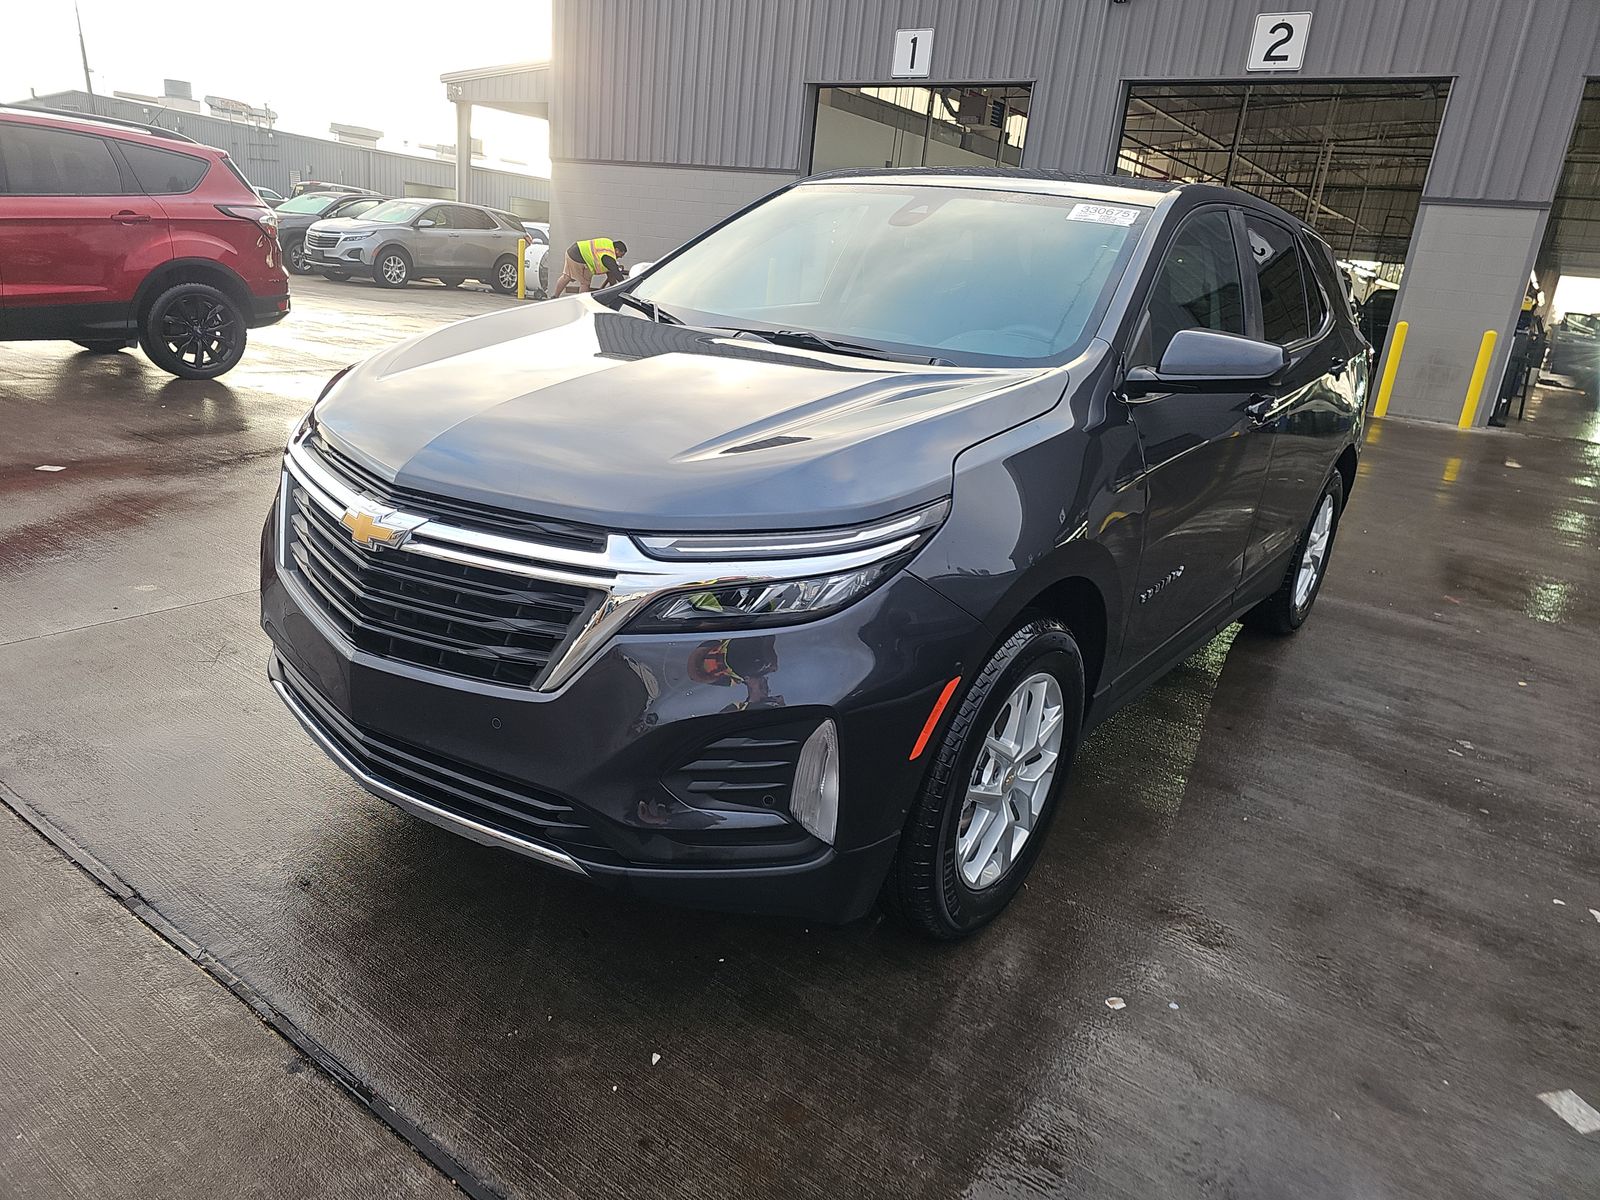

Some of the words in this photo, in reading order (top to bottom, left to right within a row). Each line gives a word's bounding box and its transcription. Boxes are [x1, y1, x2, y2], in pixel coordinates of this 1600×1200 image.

[910, 37, 918, 69] 1
[1263, 22, 1293, 61] 2
[1080, 205, 1138, 218] 3306751
